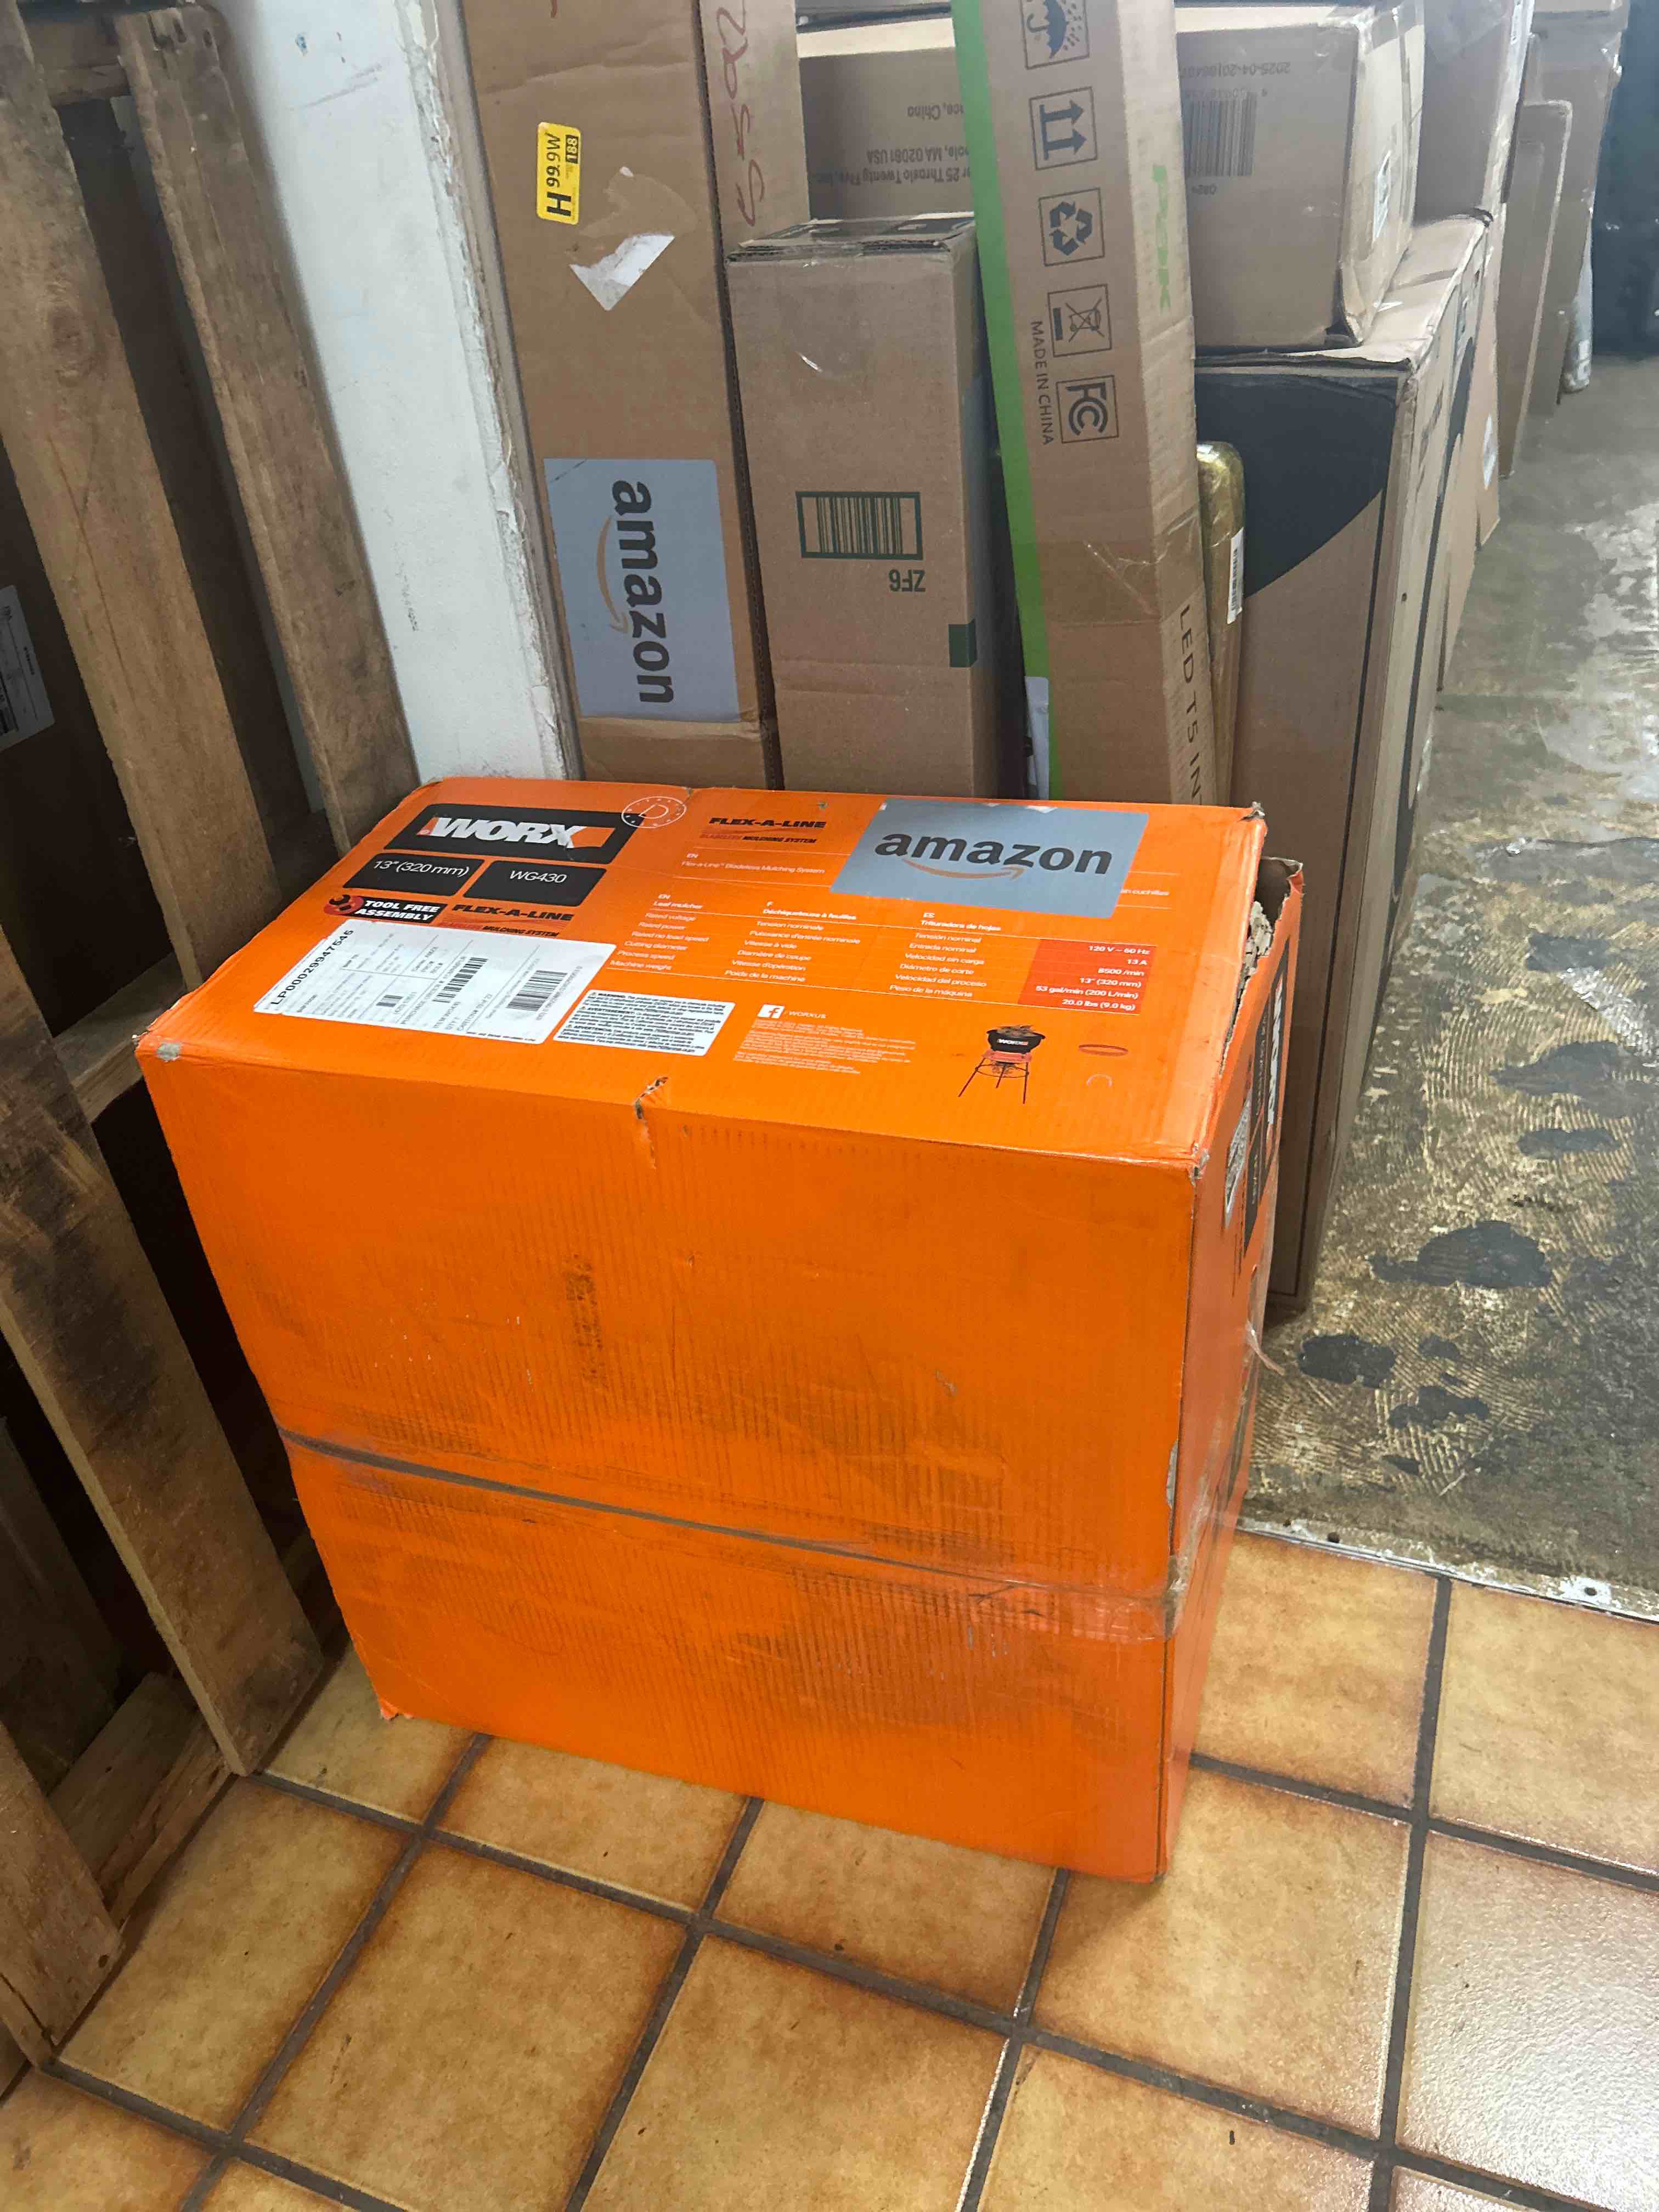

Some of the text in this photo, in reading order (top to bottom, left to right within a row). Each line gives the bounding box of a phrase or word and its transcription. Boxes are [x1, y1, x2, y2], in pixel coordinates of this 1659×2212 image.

[907, 105, 941, 120] China
[866, 149, 889, 164] USA
[924, 146, 942, 161] MA
[863, 168, 901, 184] Twenty
[946, 167, 960, 182] 25
[546, 192, 571, 217] H
[1031, 321, 1054, 445] MADE IN CHINA
[889, 569, 926, 592] ZF6
[611, 479, 674, 704] amazon
[1180, 604, 1194, 684] LED
[709, 817, 826, 828] FLEX-A-LINE
[431, 817, 587, 848] WORX
[874, 833, 1112, 874] amazon
[396, 860, 434, 875] (320
[432, 865, 470, 878] mm)
[509, 870, 567, 884] WG430
[363, 900, 440, 913] TOOL FREE
[452, 904, 574, 921] FLEX-A-LINE
[355, 909, 433, 921] ASSEMBLY
[787, 923, 824, 931] nominale
[744, 939, 773, 947] Vitesse
[749, 930, 791, 939] Puissance
[823, 936, 860, 944] nominale
[916, 933, 946, 941] Tensión
[905, 953, 946, 962] Velocidad
[769, 974, 806, 983] machine
[895, 974, 936, 983] Velocidad
[934, 989, 973, 997] máquina
[1048, 987, 1084, 995] gal/min
[1108, 991, 1138, 1000] L/min)
